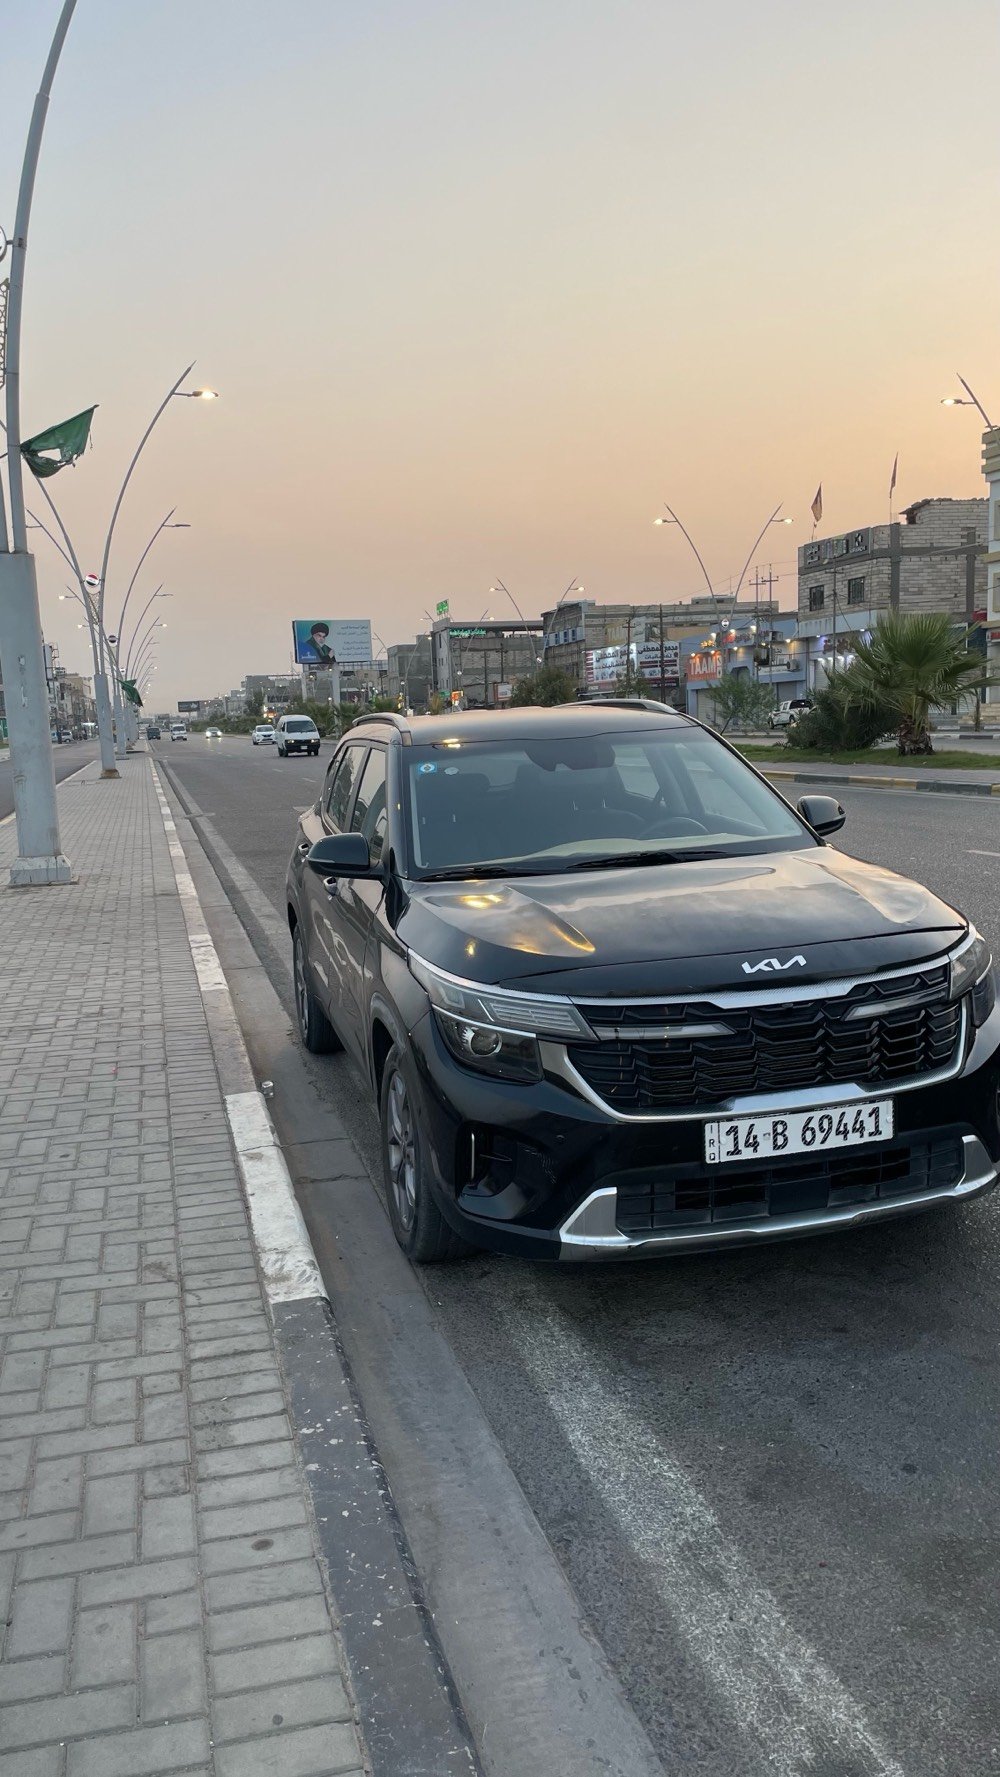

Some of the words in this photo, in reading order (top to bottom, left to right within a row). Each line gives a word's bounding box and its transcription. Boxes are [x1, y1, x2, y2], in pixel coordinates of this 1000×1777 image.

[637, 645, 662, 654] لمصطفى
[726, 1123, 760, 1156] 14
[772, 1120, 789, 1151] B
[801, 1106, 882, 1146] 69441
